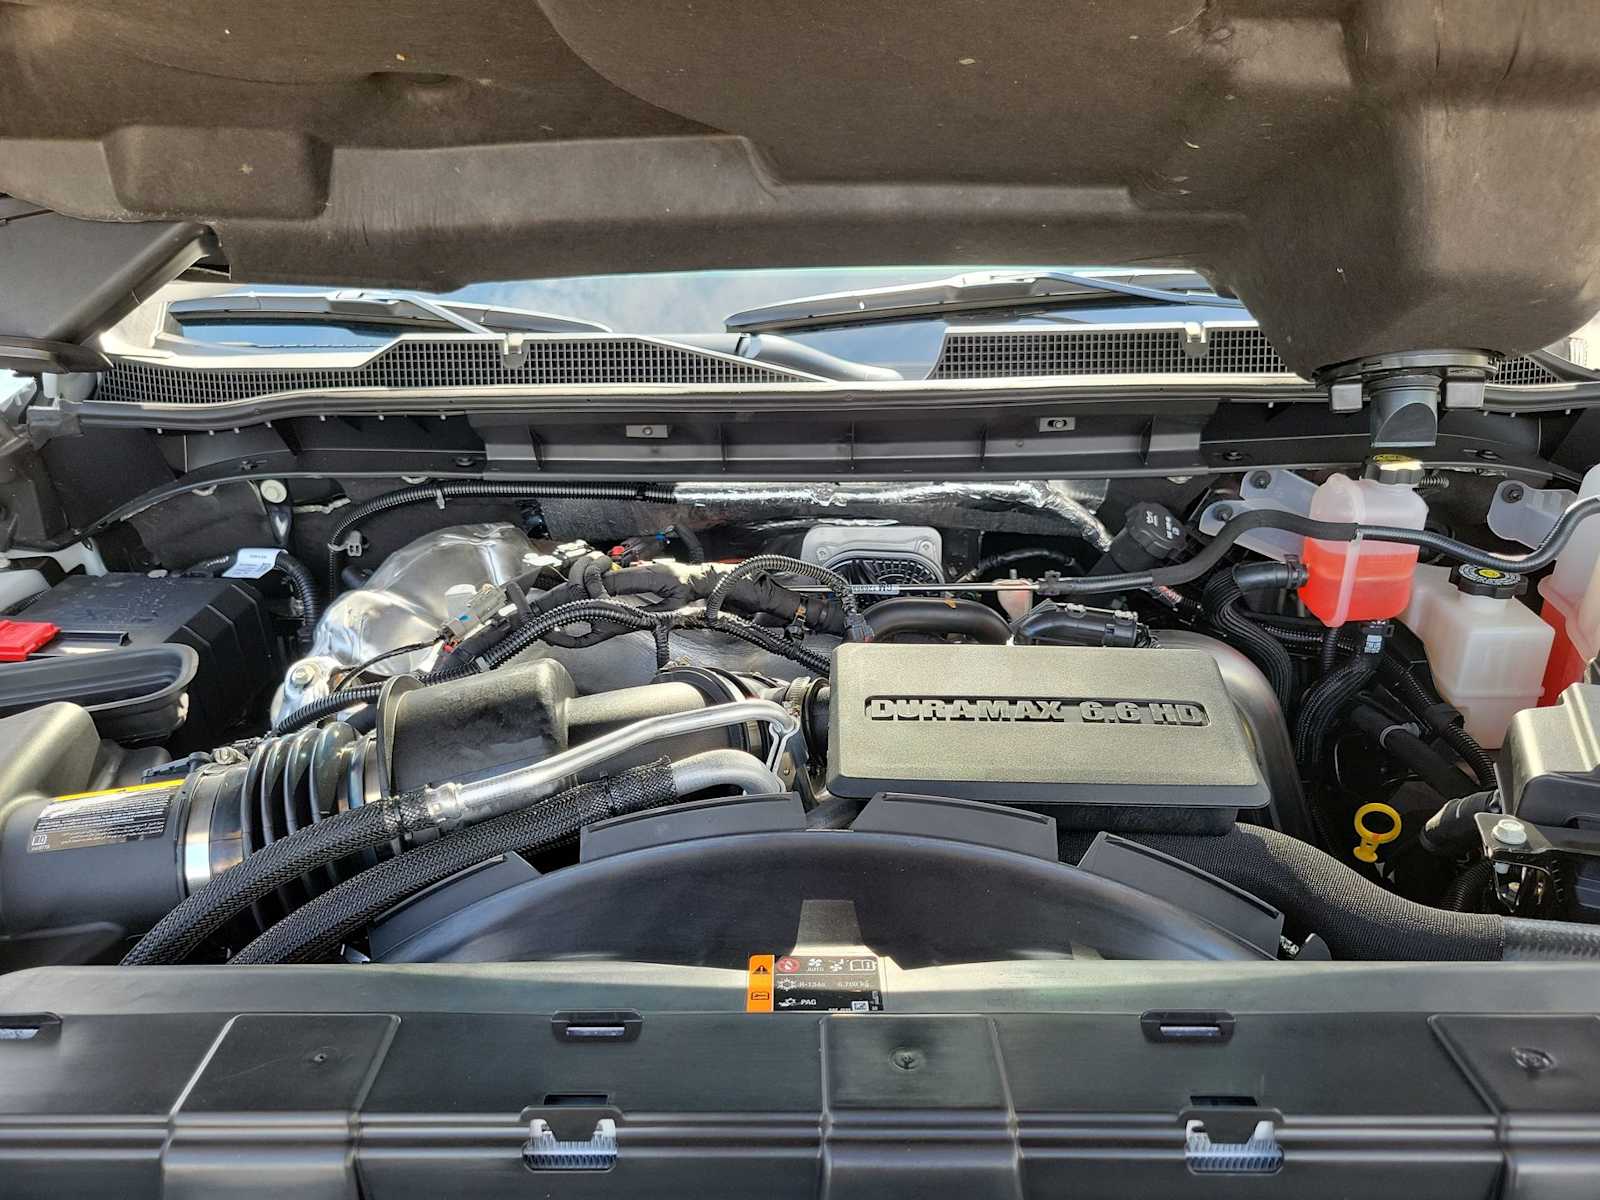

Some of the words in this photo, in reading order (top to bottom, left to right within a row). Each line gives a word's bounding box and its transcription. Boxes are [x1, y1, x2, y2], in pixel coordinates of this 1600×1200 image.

[870, 699, 1064, 722] DURAMAX
[1079, 701, 1142, 724] 6.6
[1149, 703, 1204, 725] HD
